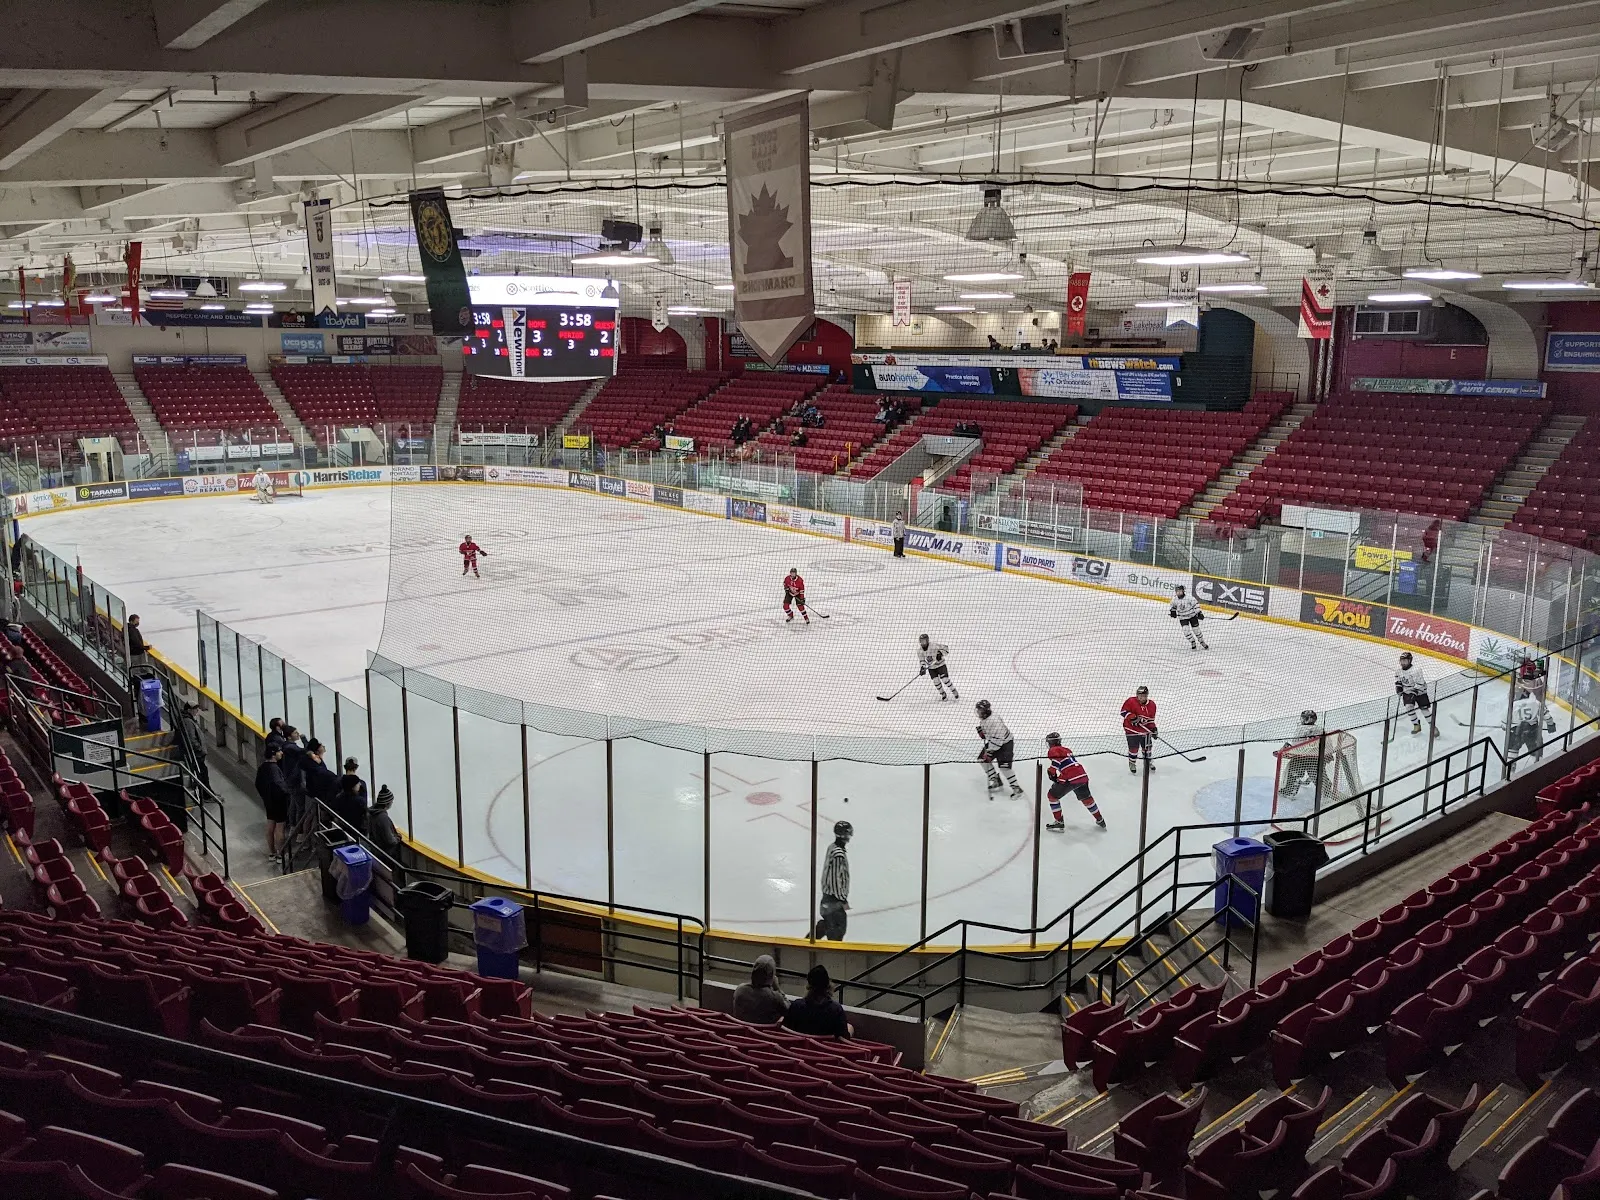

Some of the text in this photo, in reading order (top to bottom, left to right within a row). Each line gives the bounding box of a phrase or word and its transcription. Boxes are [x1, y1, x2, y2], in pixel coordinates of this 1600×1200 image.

[518, 283, 554, 294] Scotties
[325, 314, 360, 328] tbaytel
[473, 312, 491, 325] 3:58
[560, 313, 592, 326] 3:58
[511, 309, 526, 376] Newmont
[532, 331, 542, 343] 3
[601, 331, 609, 343] 2
[300, 340, 322, 350] 95.1
[568, 340, 575, 350] 3
[543, 348, 553, 356] 22
[1451, 348, 1457, 360] E
[879, 372, 918, 383] autohome
[1485, 387, 1520, 395] CENTRE
[313, 470, 383, 482] HarrisRebar
[90, 487, 123, 498] TARANIS
[200, 486, 226, 494] REPAIR
[907, 533, 964, 554] WINMAR
[1022, 555, 1056, 569] AUTO PARTS
[1362, 551, 1389, 562] POWER
[1072, 557, 1111, 578] FGI
[1390, 617, 1413, 637] Tim
[1414, 622, 1466, 653] Hortons
[1517, 708, 1532, 721] 15
